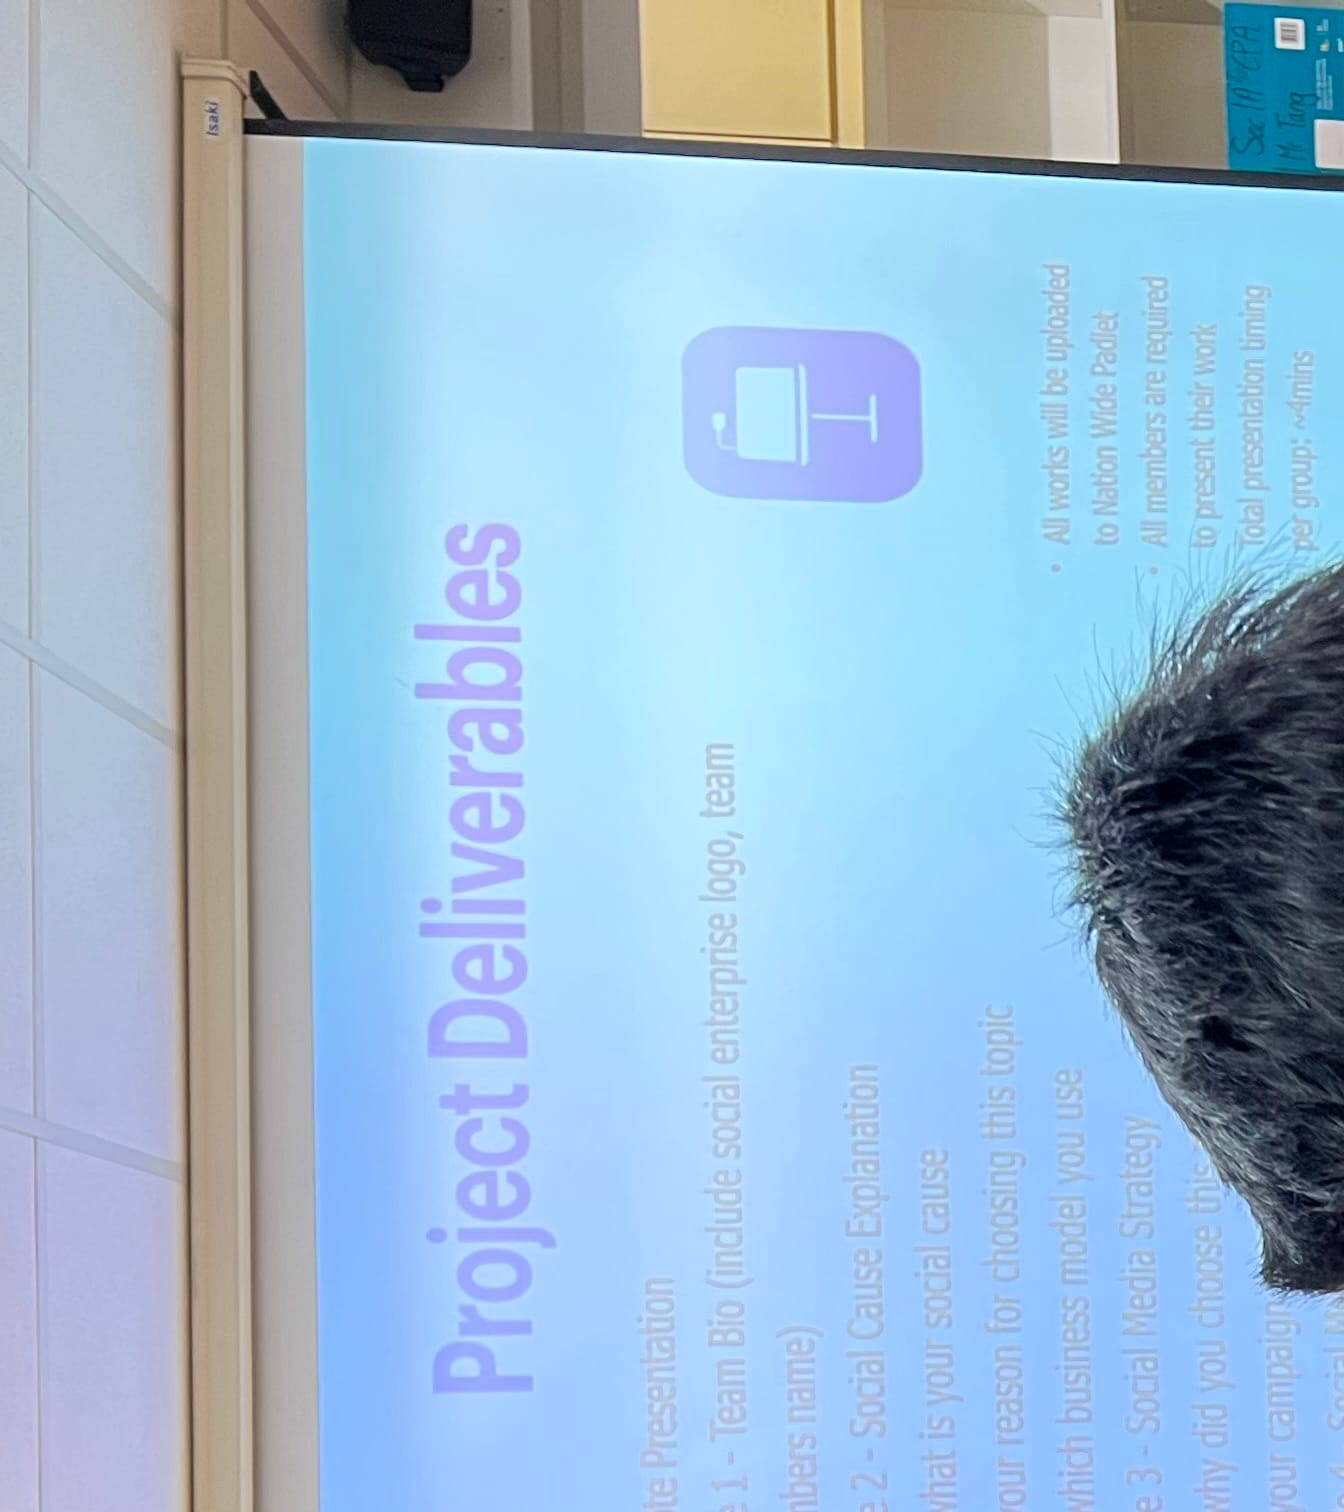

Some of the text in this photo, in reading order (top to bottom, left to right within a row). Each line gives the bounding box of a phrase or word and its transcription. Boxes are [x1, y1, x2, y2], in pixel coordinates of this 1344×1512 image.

[1039, 264, 1074, 545] All works will be uploaded
[1088, 312, 1119, 545] to Nation Wide Padlet
[1138, 276, 1174, 548] All members are required
[1186, 324, 1222, 549] to present their work
[1235, 285, 1272, 547] Total presentation timing
[1284, 350, 1320, 551] per group: ~4mins
[699, 742, 737, 819] team
[698, 830, 746, 903] logo,
[413, 523, 556, 1394] Project Deliverables
[699, 913, 748, 1065] enterprise
[976, 1004, 1024, 1076] topic
[701, 1076, 741, 1159] social
[978, 1087, 1016, 1140] this
[1055, 1069, 1084, 1120] use
[842, 1064, 889, 1237] Explanation
[919, 1149, 950, 1234] cause
[1055, 1132, 1094, 1185] you
[1118, 1115, 1162, 1239] Strategy
[1183, 1164, 1221, 1215] this
[703, 1169, 754, 1290] (include
[979, 1151, 1027, 1283] choosing
[1048, 1196, 1088, 1285] model
[846, 1248, 885, 1340] Cause
[912, 1246, 952, 1328] social
[984, 1294, 1021, 1334] for
[1116, 1250, 1158, 1336] Media
[1188, 1224, 1225, 1329] choose
[708, 1301, 745, 1347] Bio
[1054, 1296, 1093, 1424] business
[1199, 1340, 1236, 1391] you
[637, 1277, 678, 1468] Presentation
[709, 1358, 748, 1443] Team
[775, 1326, 824, 1423] name)
[846, 1351, 886, 1439] Social
[924, 1338, 964, 1406] your
[992, 1345, 1025, 1445] reason
[1120, 1348, 1160, 1434] Social
[918, 1415, 955, 1439] is
[1192, 1403, 1229, 1448] did
[711, 1475, 748, 1493] 1
[850, 1472, 888, 1490] 2
[1126, 1468, 1162, 1486] 3
